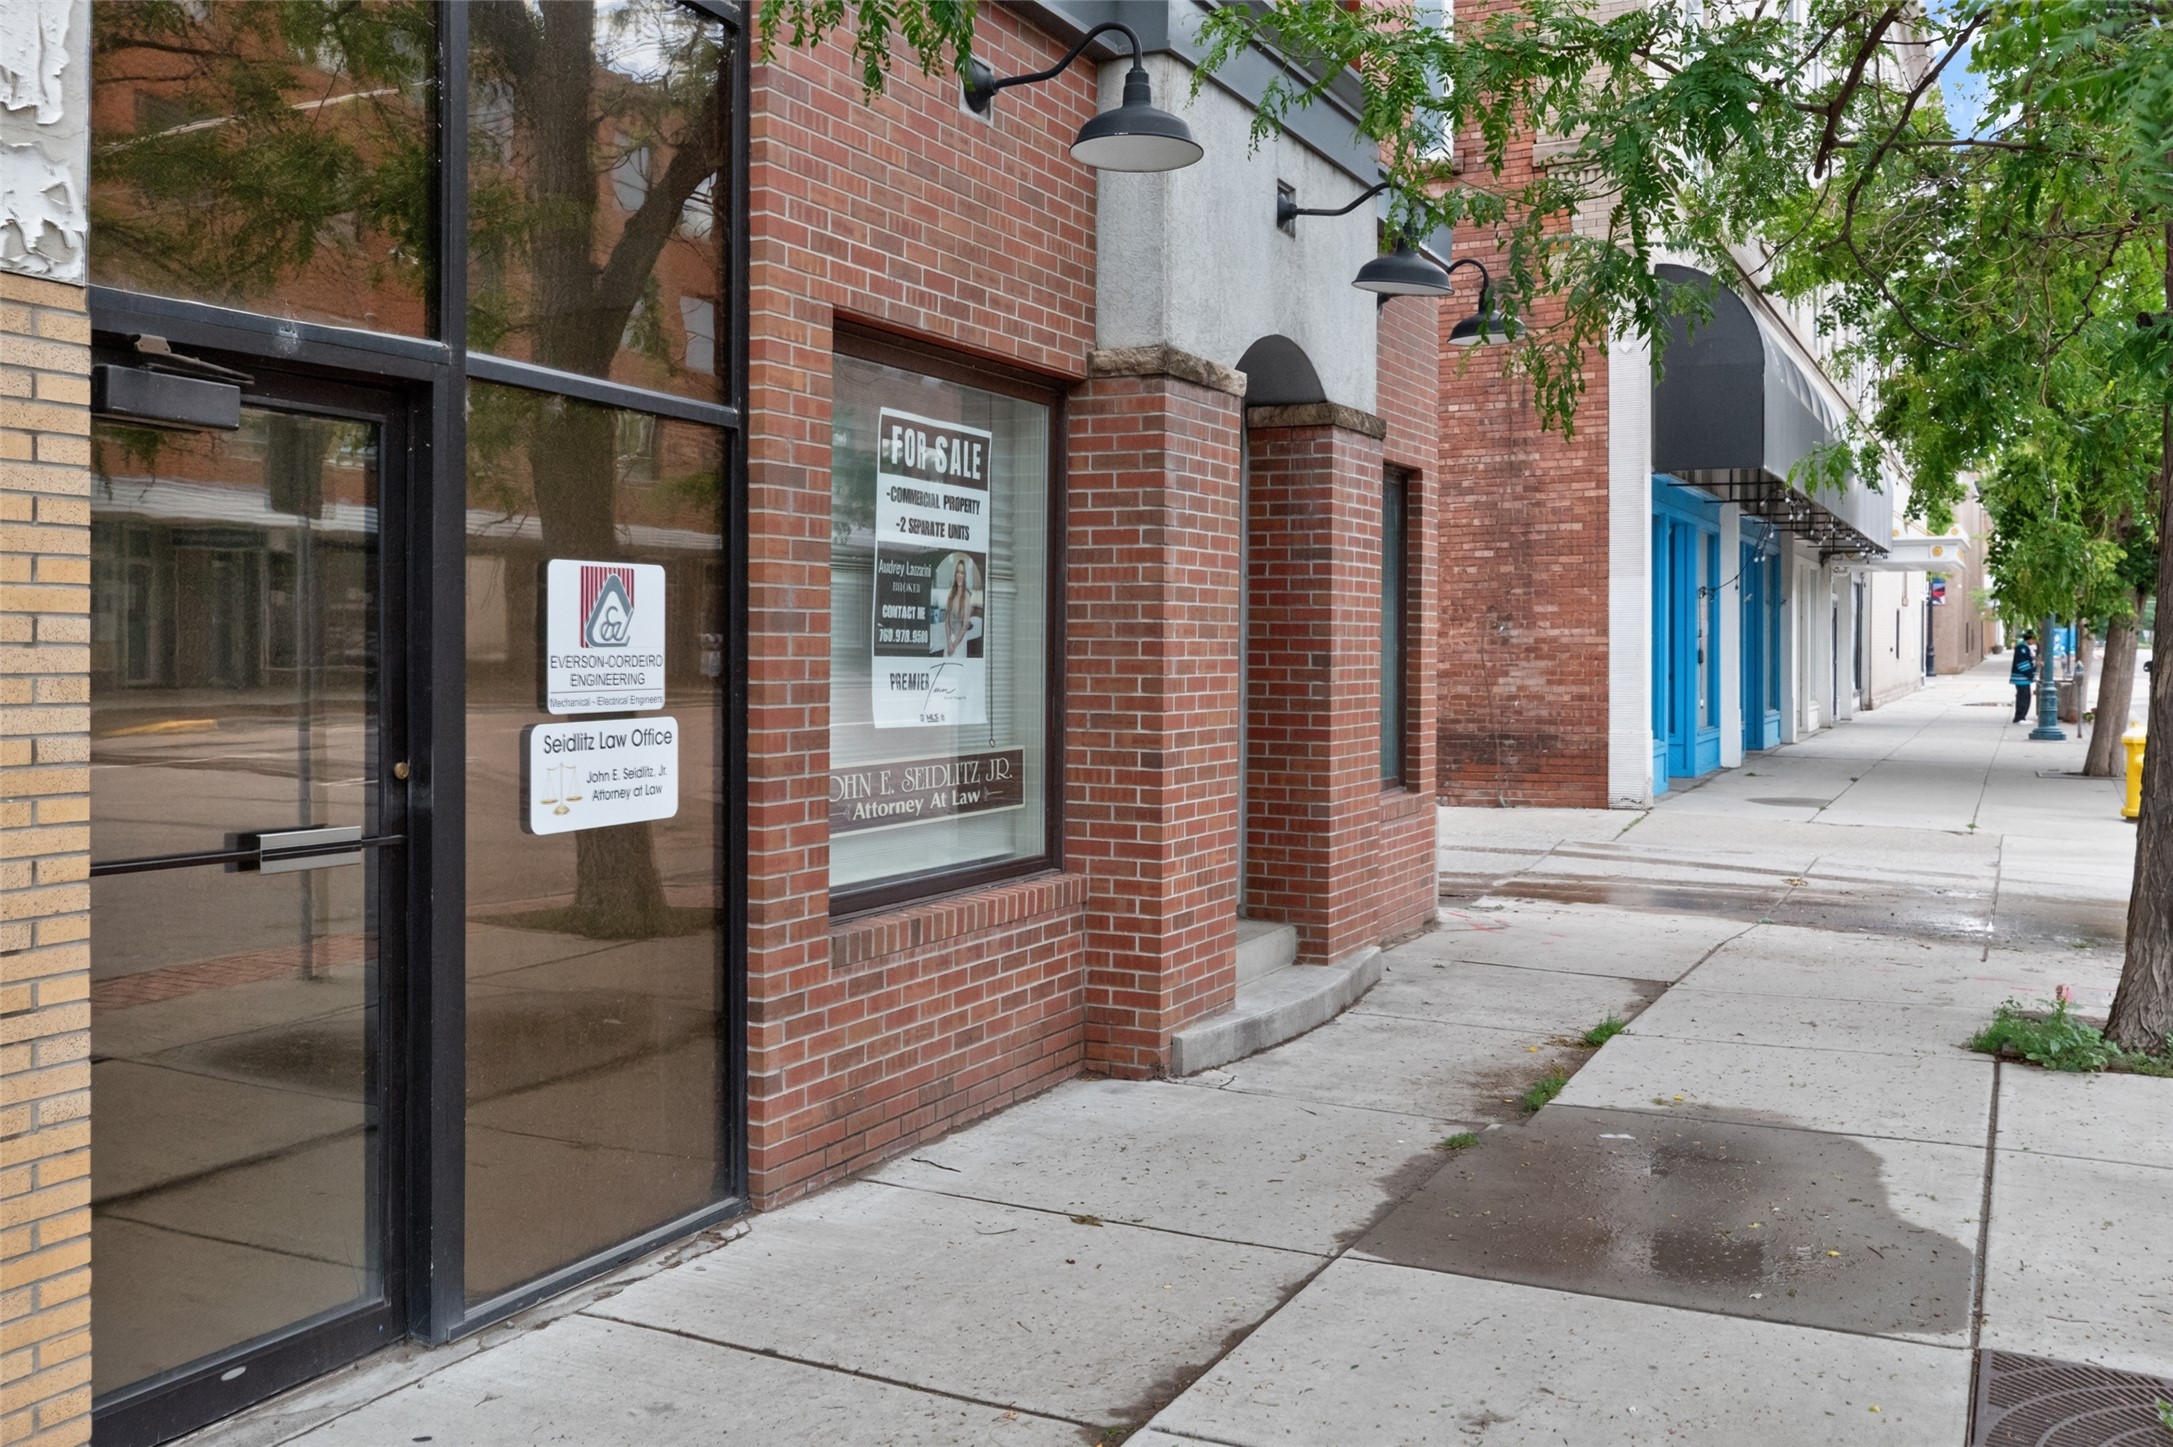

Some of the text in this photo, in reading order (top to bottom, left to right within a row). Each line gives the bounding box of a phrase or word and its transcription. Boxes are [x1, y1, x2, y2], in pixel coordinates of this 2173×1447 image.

[891, 425, 981, 480] FOR SALE
[886, 485, 980, 515] -COMMERCIAL PROPERTY
[908, 517, 946, 538] SEPARATE
[947, 523, 970, 541] UNITS
[878, 558, 905, 577] Audrey
[892, 582, 921, 593] BROKER
[882, 604, 926, 620] CONTACT ME
[550, 654, 663, 669] EVERSON-CORDEIRO
[570, 672, 646, 687] ENGINEERING
[889, 672, 930, 691] PREMIER
[550, 698, 591, 708] Mechanical
[597, 696, 628, 706] Electrical
[630, 694, 663, 706] Engineers
[543, 728, 672, 754] Seidlitz Law Office
[586, 764, 668, 784] John E. Seidlitz, Jr.
[830, 757, 1013, 802] OHN E. SEIDLITZ JR.
[592, 783, 663, 802] Attorney at Law
[852, 789, 981, 821] Attorney At Law
